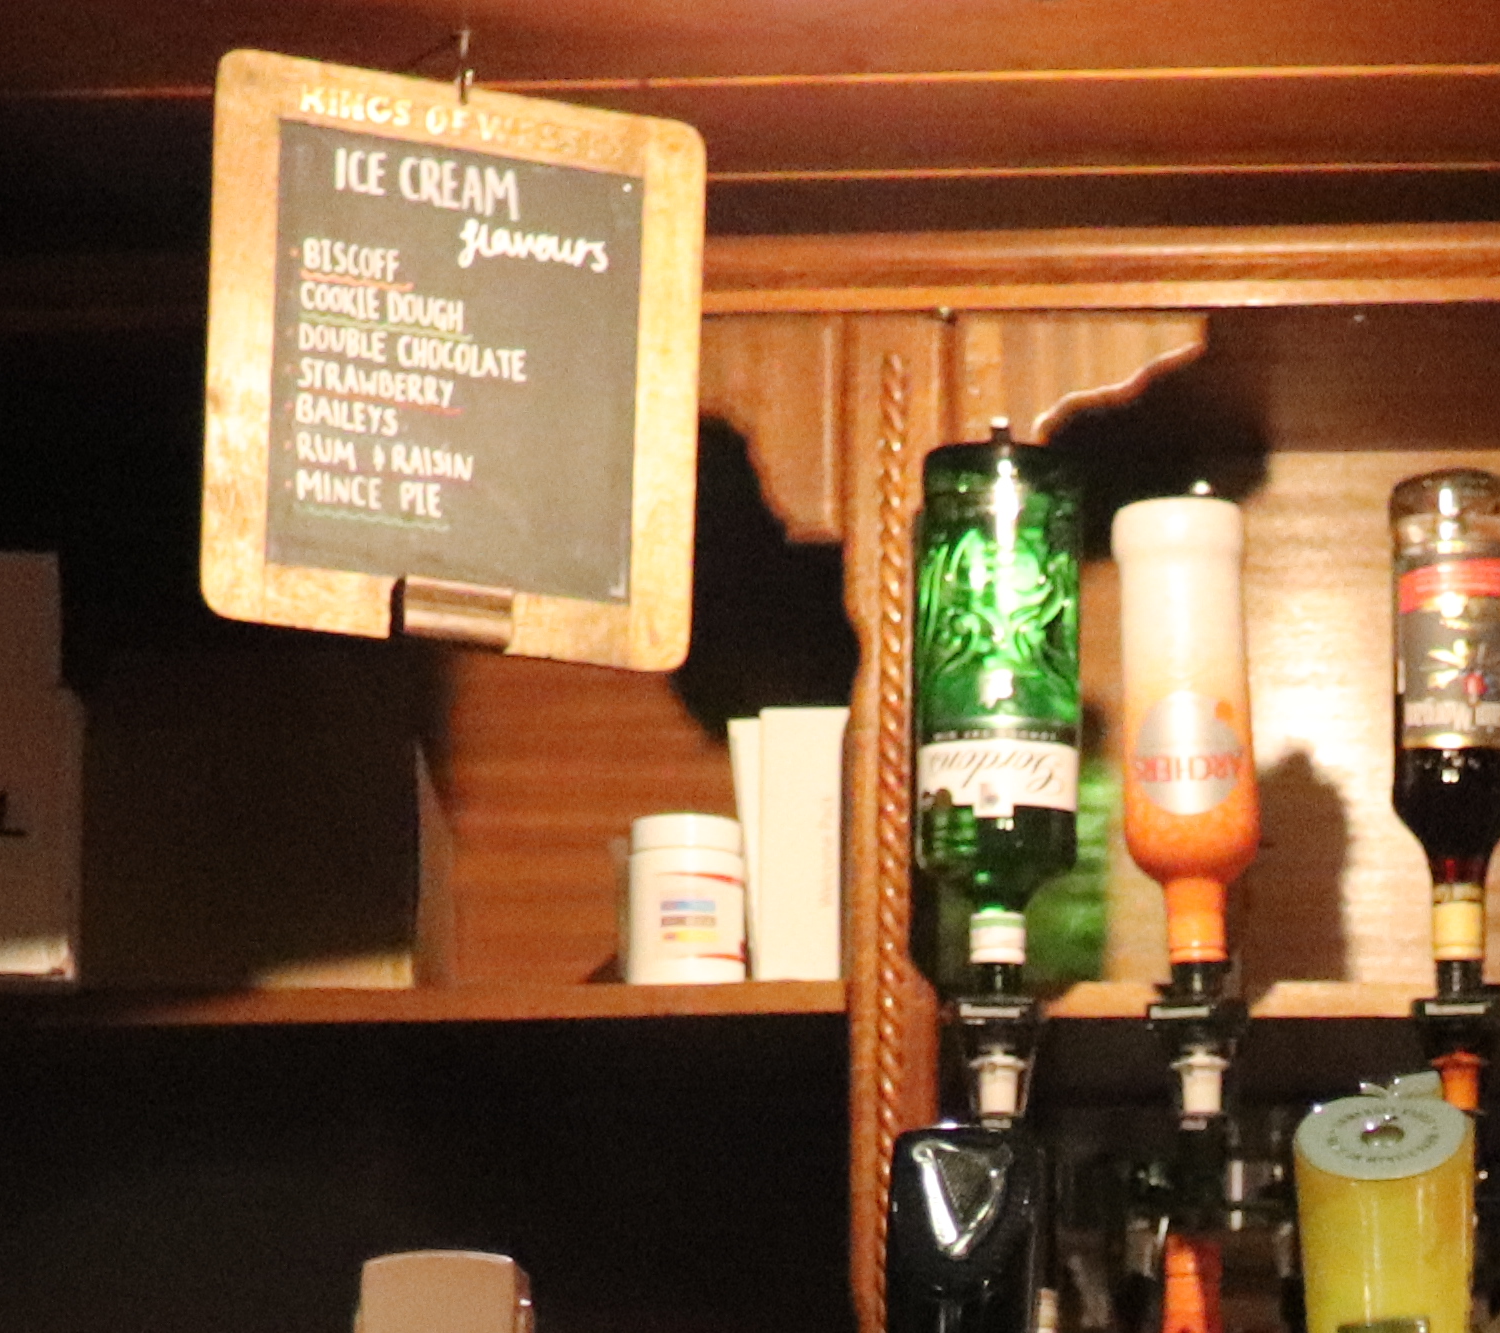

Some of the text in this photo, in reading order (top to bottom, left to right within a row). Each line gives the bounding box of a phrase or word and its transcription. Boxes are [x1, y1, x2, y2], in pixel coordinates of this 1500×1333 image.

[334, 147, 521, 222] ICE CREAM
[302, 238, 400, 283] BISCOFF
[300, 283, 464, 333] COOKIE DOUGH
[298, 323, 527, 382] DOUBLE CHOCOLATE
[298, 361, 454, 408] STRAWBERRY
[295, 396, 399, 436] BAILEYS
[296, 435, 357, 471] RUM
[390, 444, 474, 482] RAISIN
[295, 469, 443, 518] MINCE PIE
